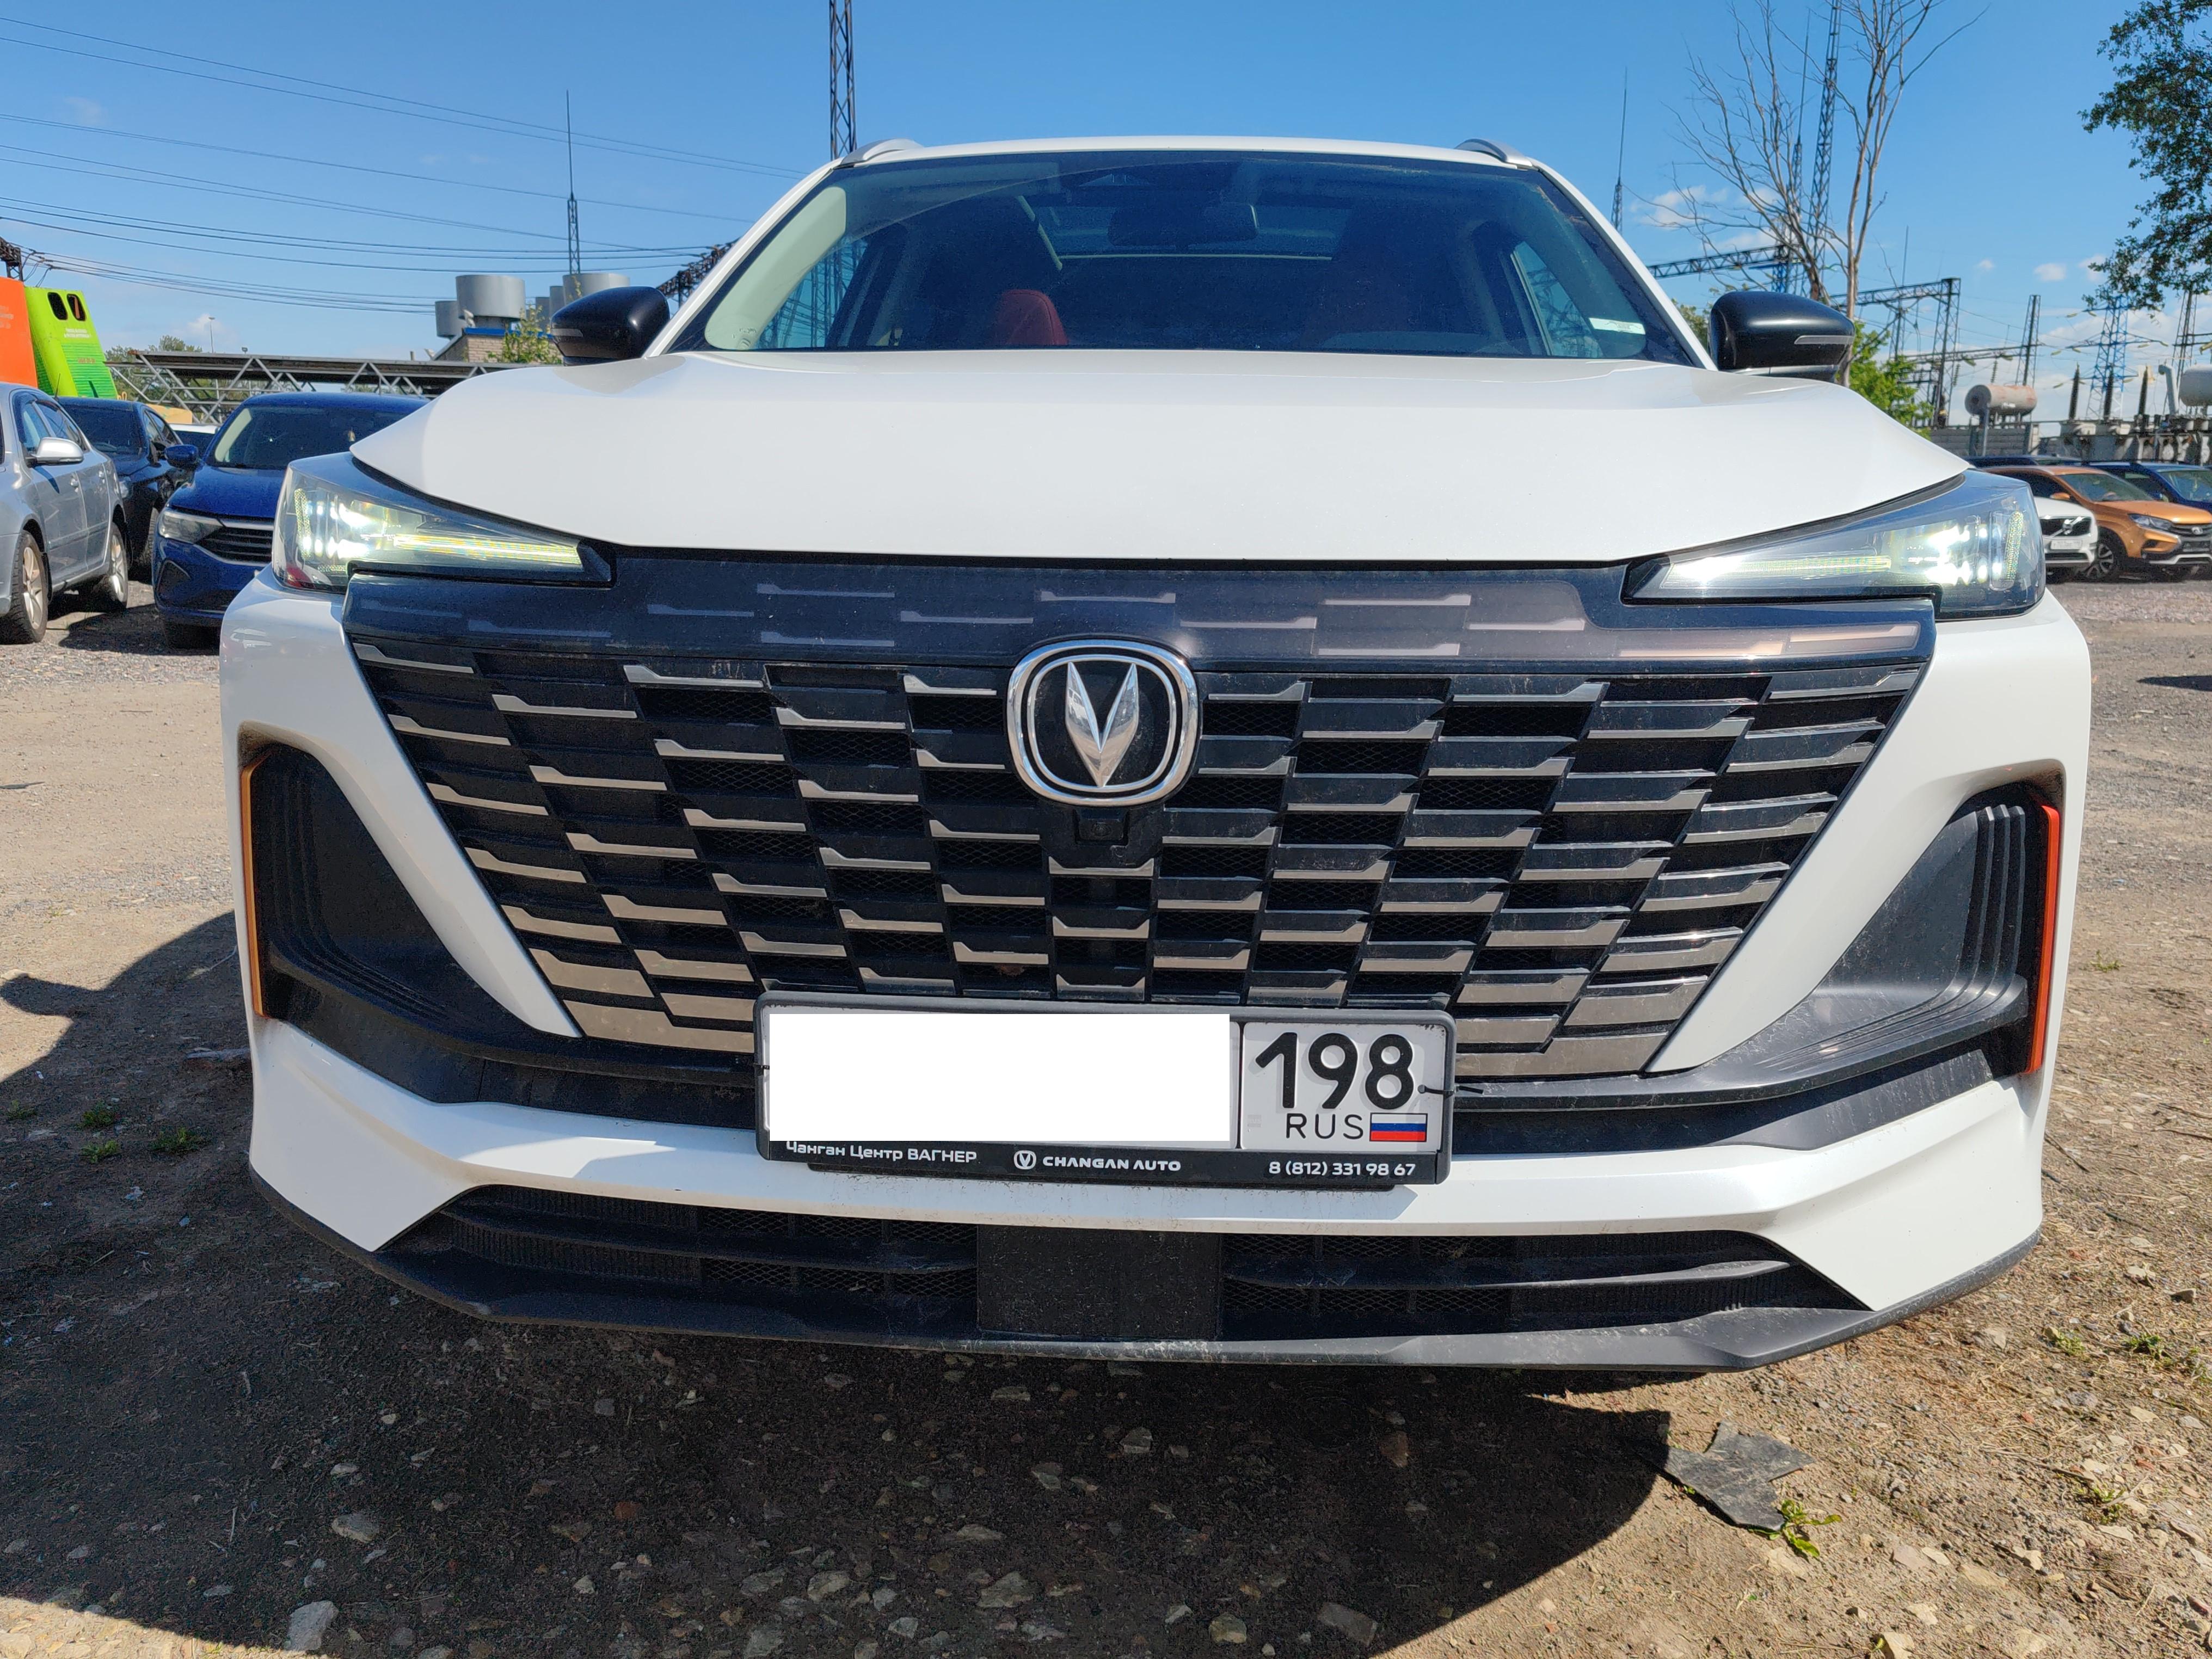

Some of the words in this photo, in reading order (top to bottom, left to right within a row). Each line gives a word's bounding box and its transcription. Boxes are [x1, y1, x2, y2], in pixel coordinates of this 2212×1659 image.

[1255, 1031, 1414, 1110] 198
[1286, 1113, 1363, 1139] RUS
[787, 1141, 845, 1156] Чанган
[850, 1145, 903, 1161] Центр
[907, 1148, 977, 1163] ВАГНЕР
[1042, 1156, 1129, 1170] CHANGAN
[1133, 1160, 1181, 1171] AUTO
[1269, 1162, 1281, 1174] 8
[1286, 1160, 1328, 1176] (812)
[1332, 1163, 1361, 1175] 331
[1366, 1163, 1389, 1176] 98
[1393, 1163, 1416, 1176] 67
